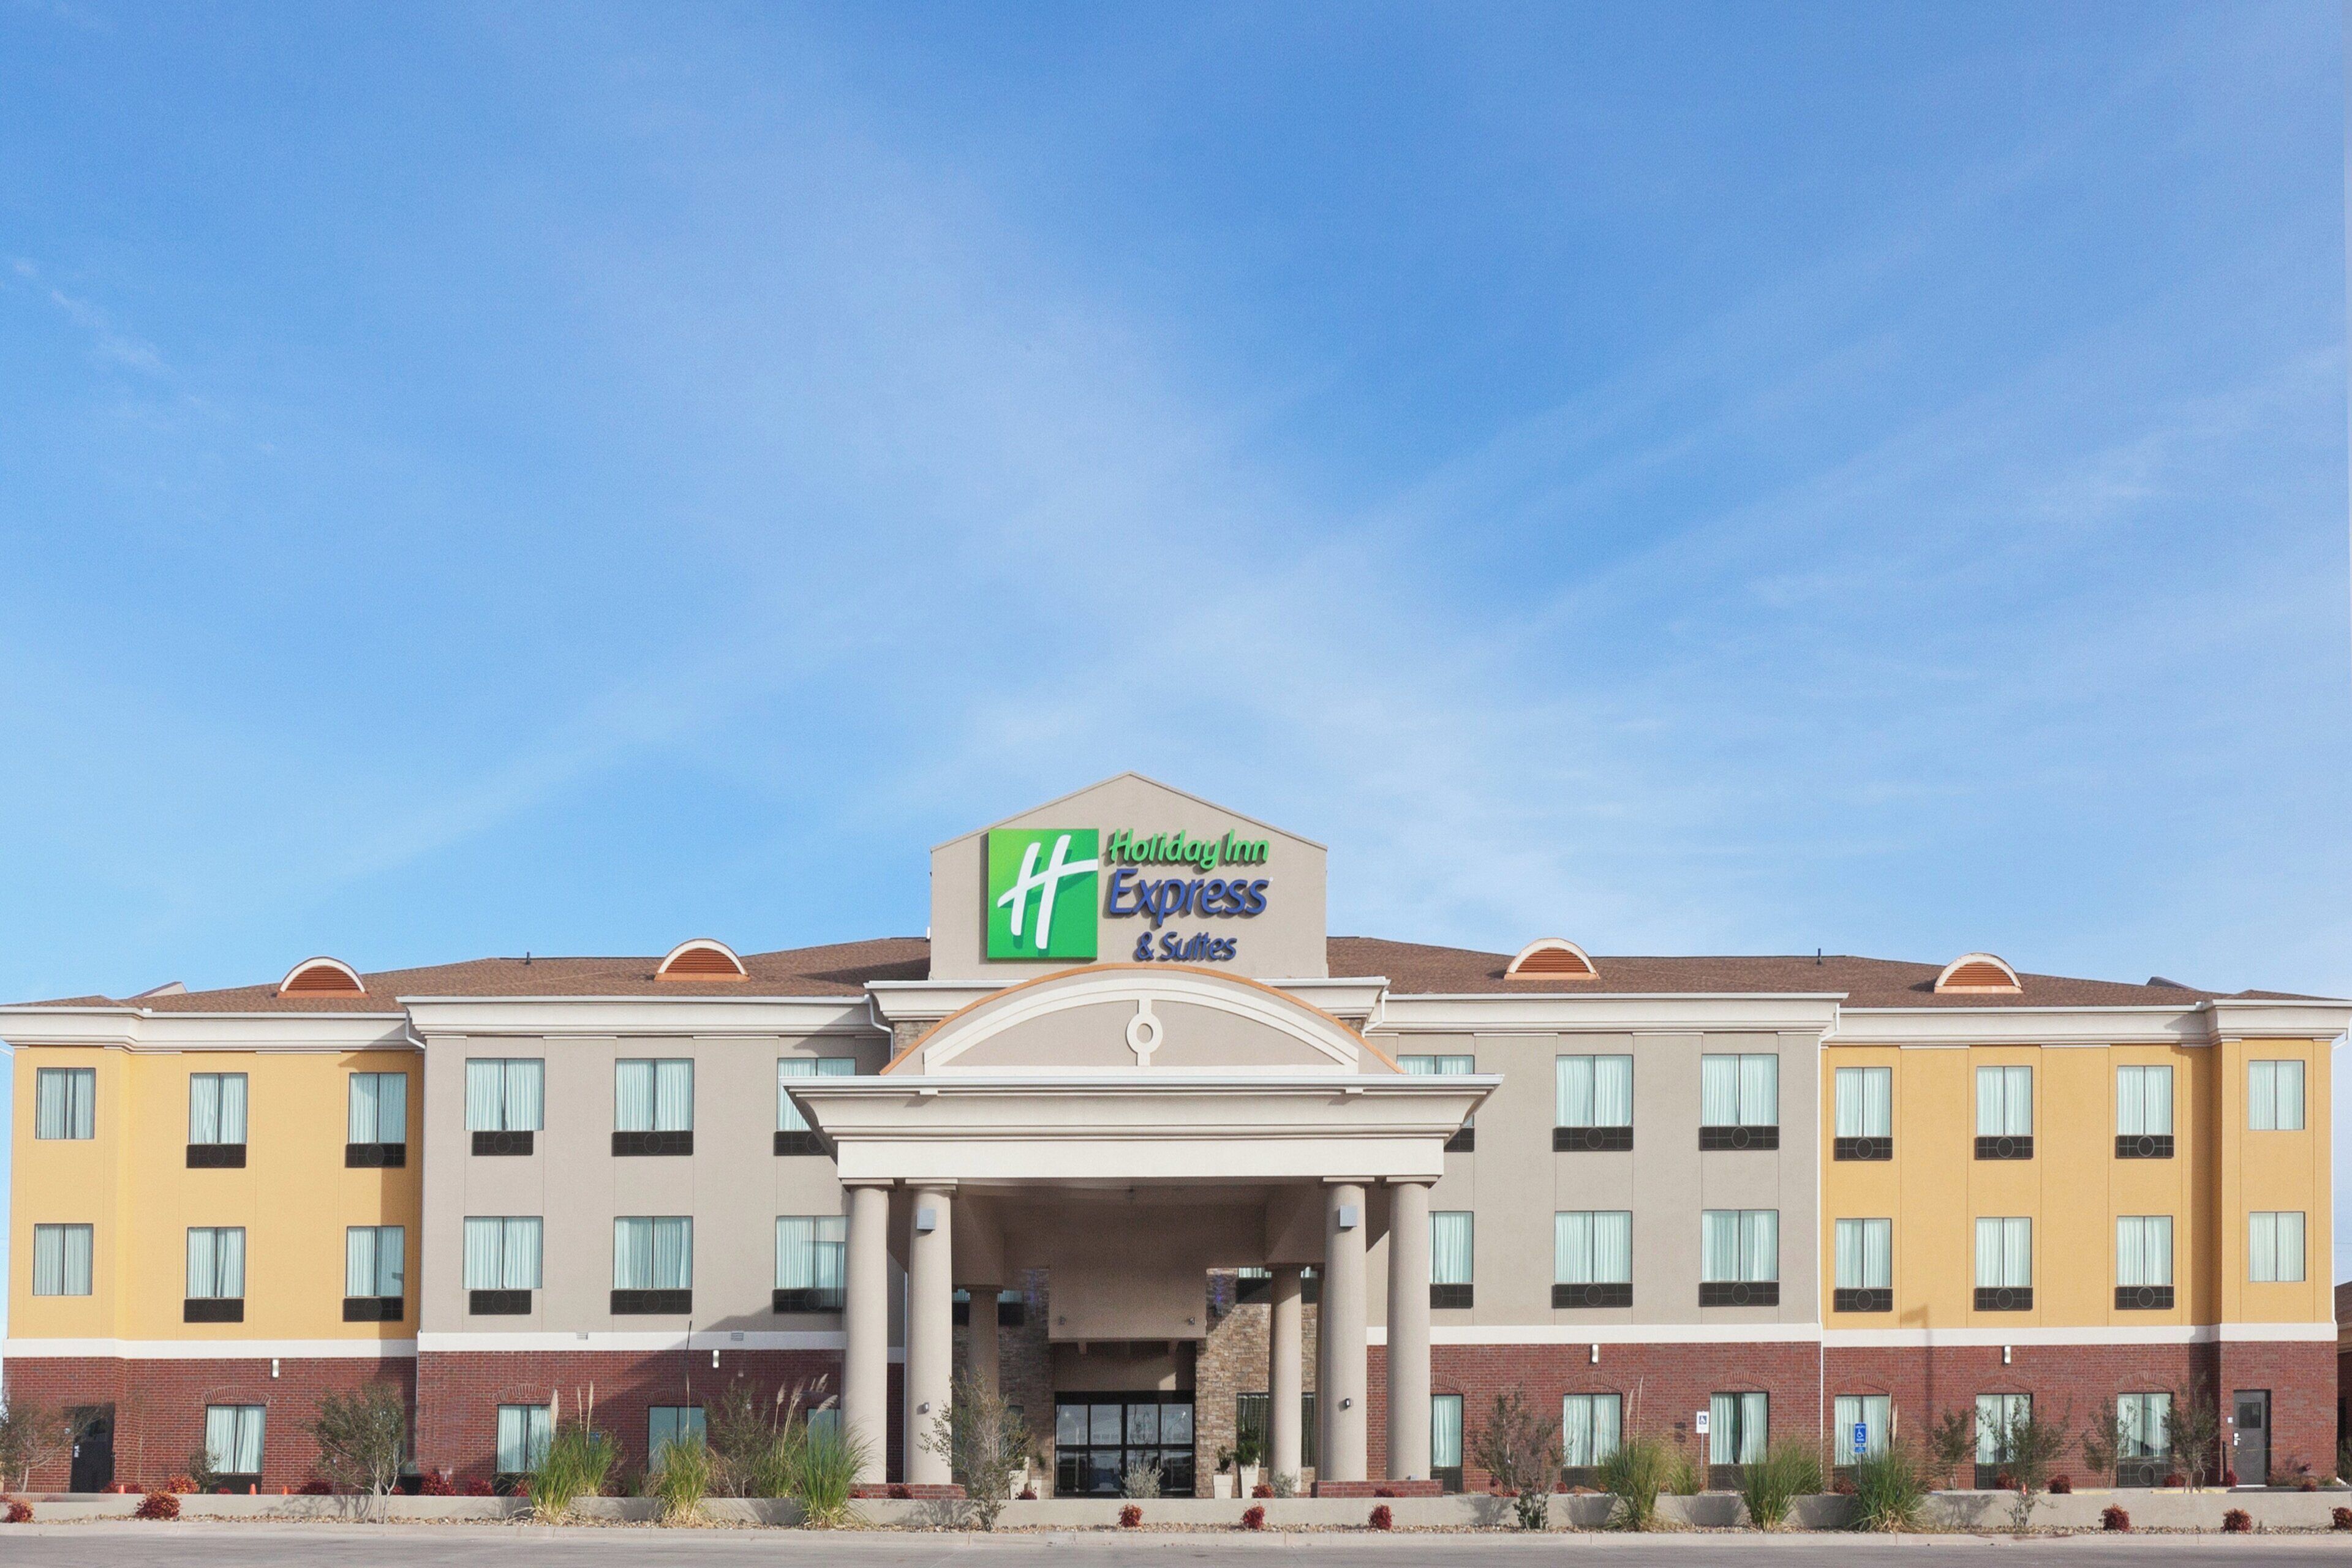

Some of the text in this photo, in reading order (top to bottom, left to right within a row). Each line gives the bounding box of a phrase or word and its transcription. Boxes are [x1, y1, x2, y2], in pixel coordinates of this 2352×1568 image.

[1109, 829, 1269, 870] Holiday Inn
[1109, 868, 1270, 926] Express
[1136, 931, 1237, 960] & Suites
